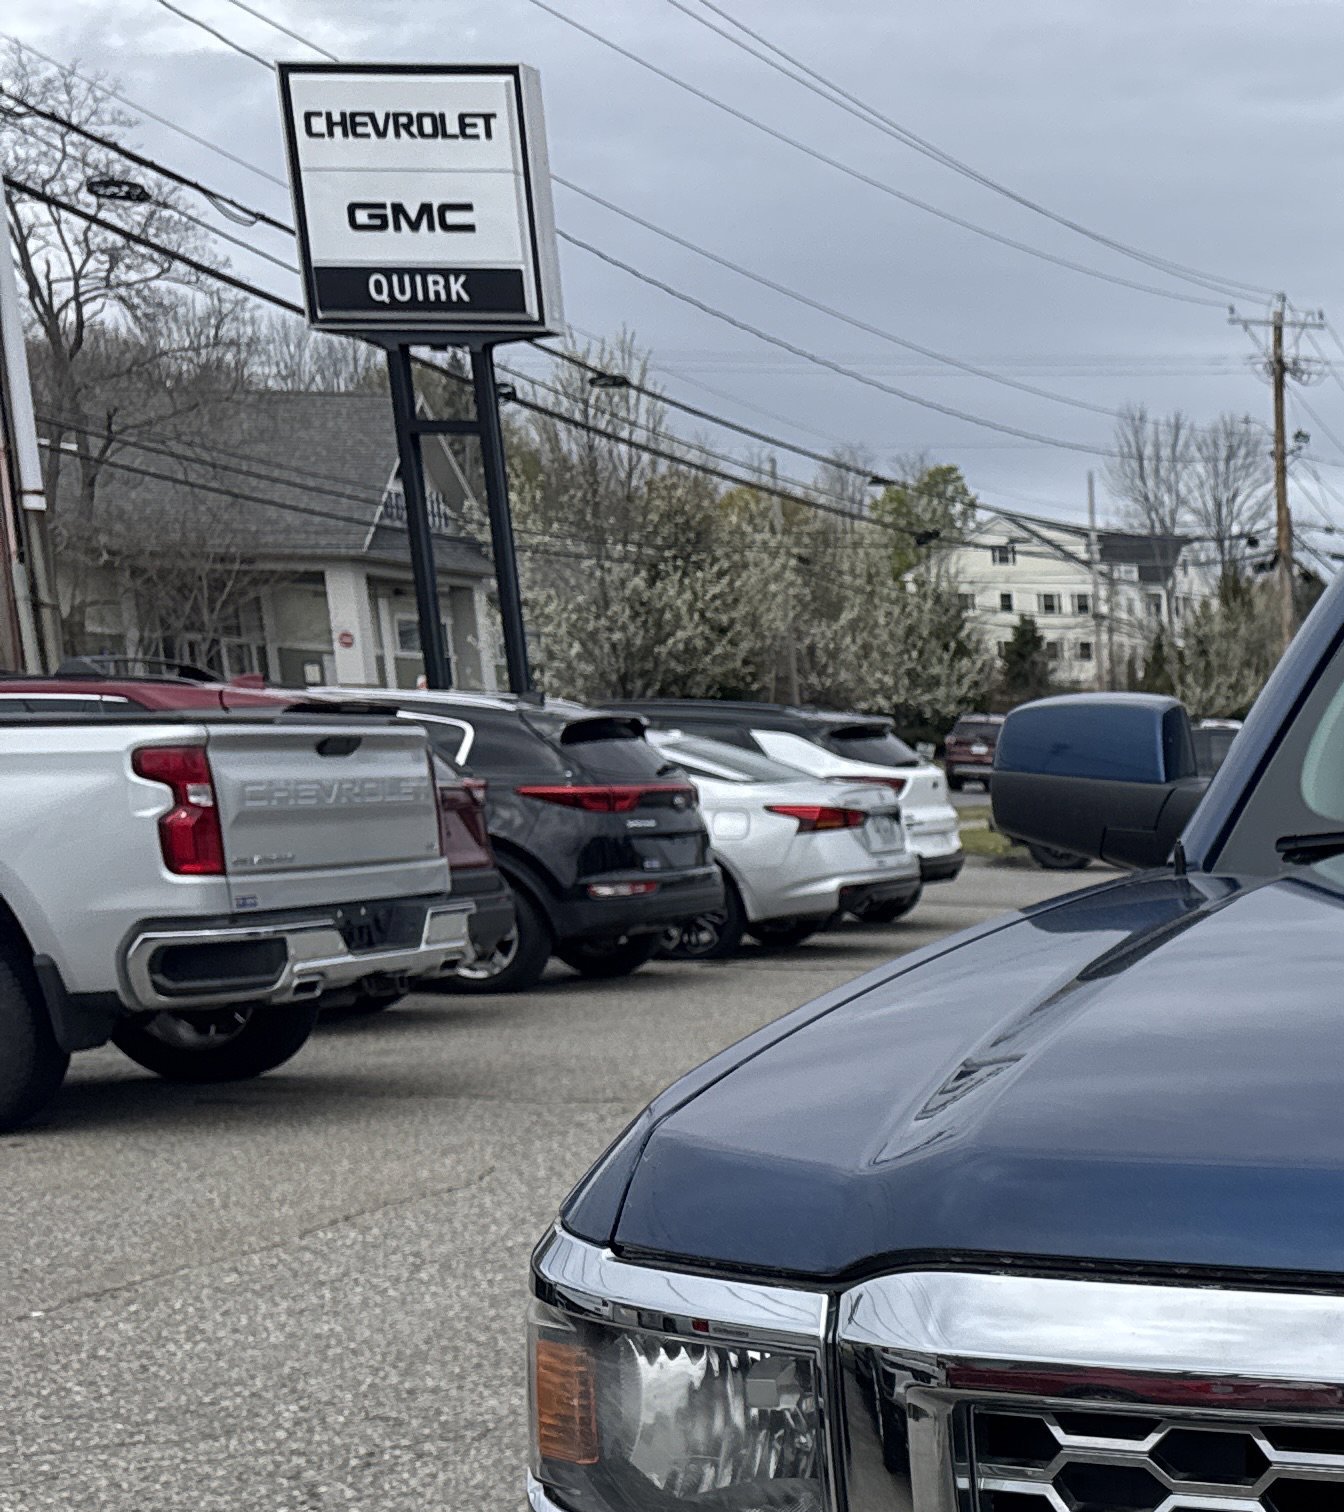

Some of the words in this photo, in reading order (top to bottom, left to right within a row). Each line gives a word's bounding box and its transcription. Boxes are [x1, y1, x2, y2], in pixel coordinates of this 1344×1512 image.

[304, 111, 497, 139] CHEVROLET
[347, 202, 476, 233] GMC
[368, 273, 471, 304] QUIRK
[244, 778, 430, 807] CHEVROLET
